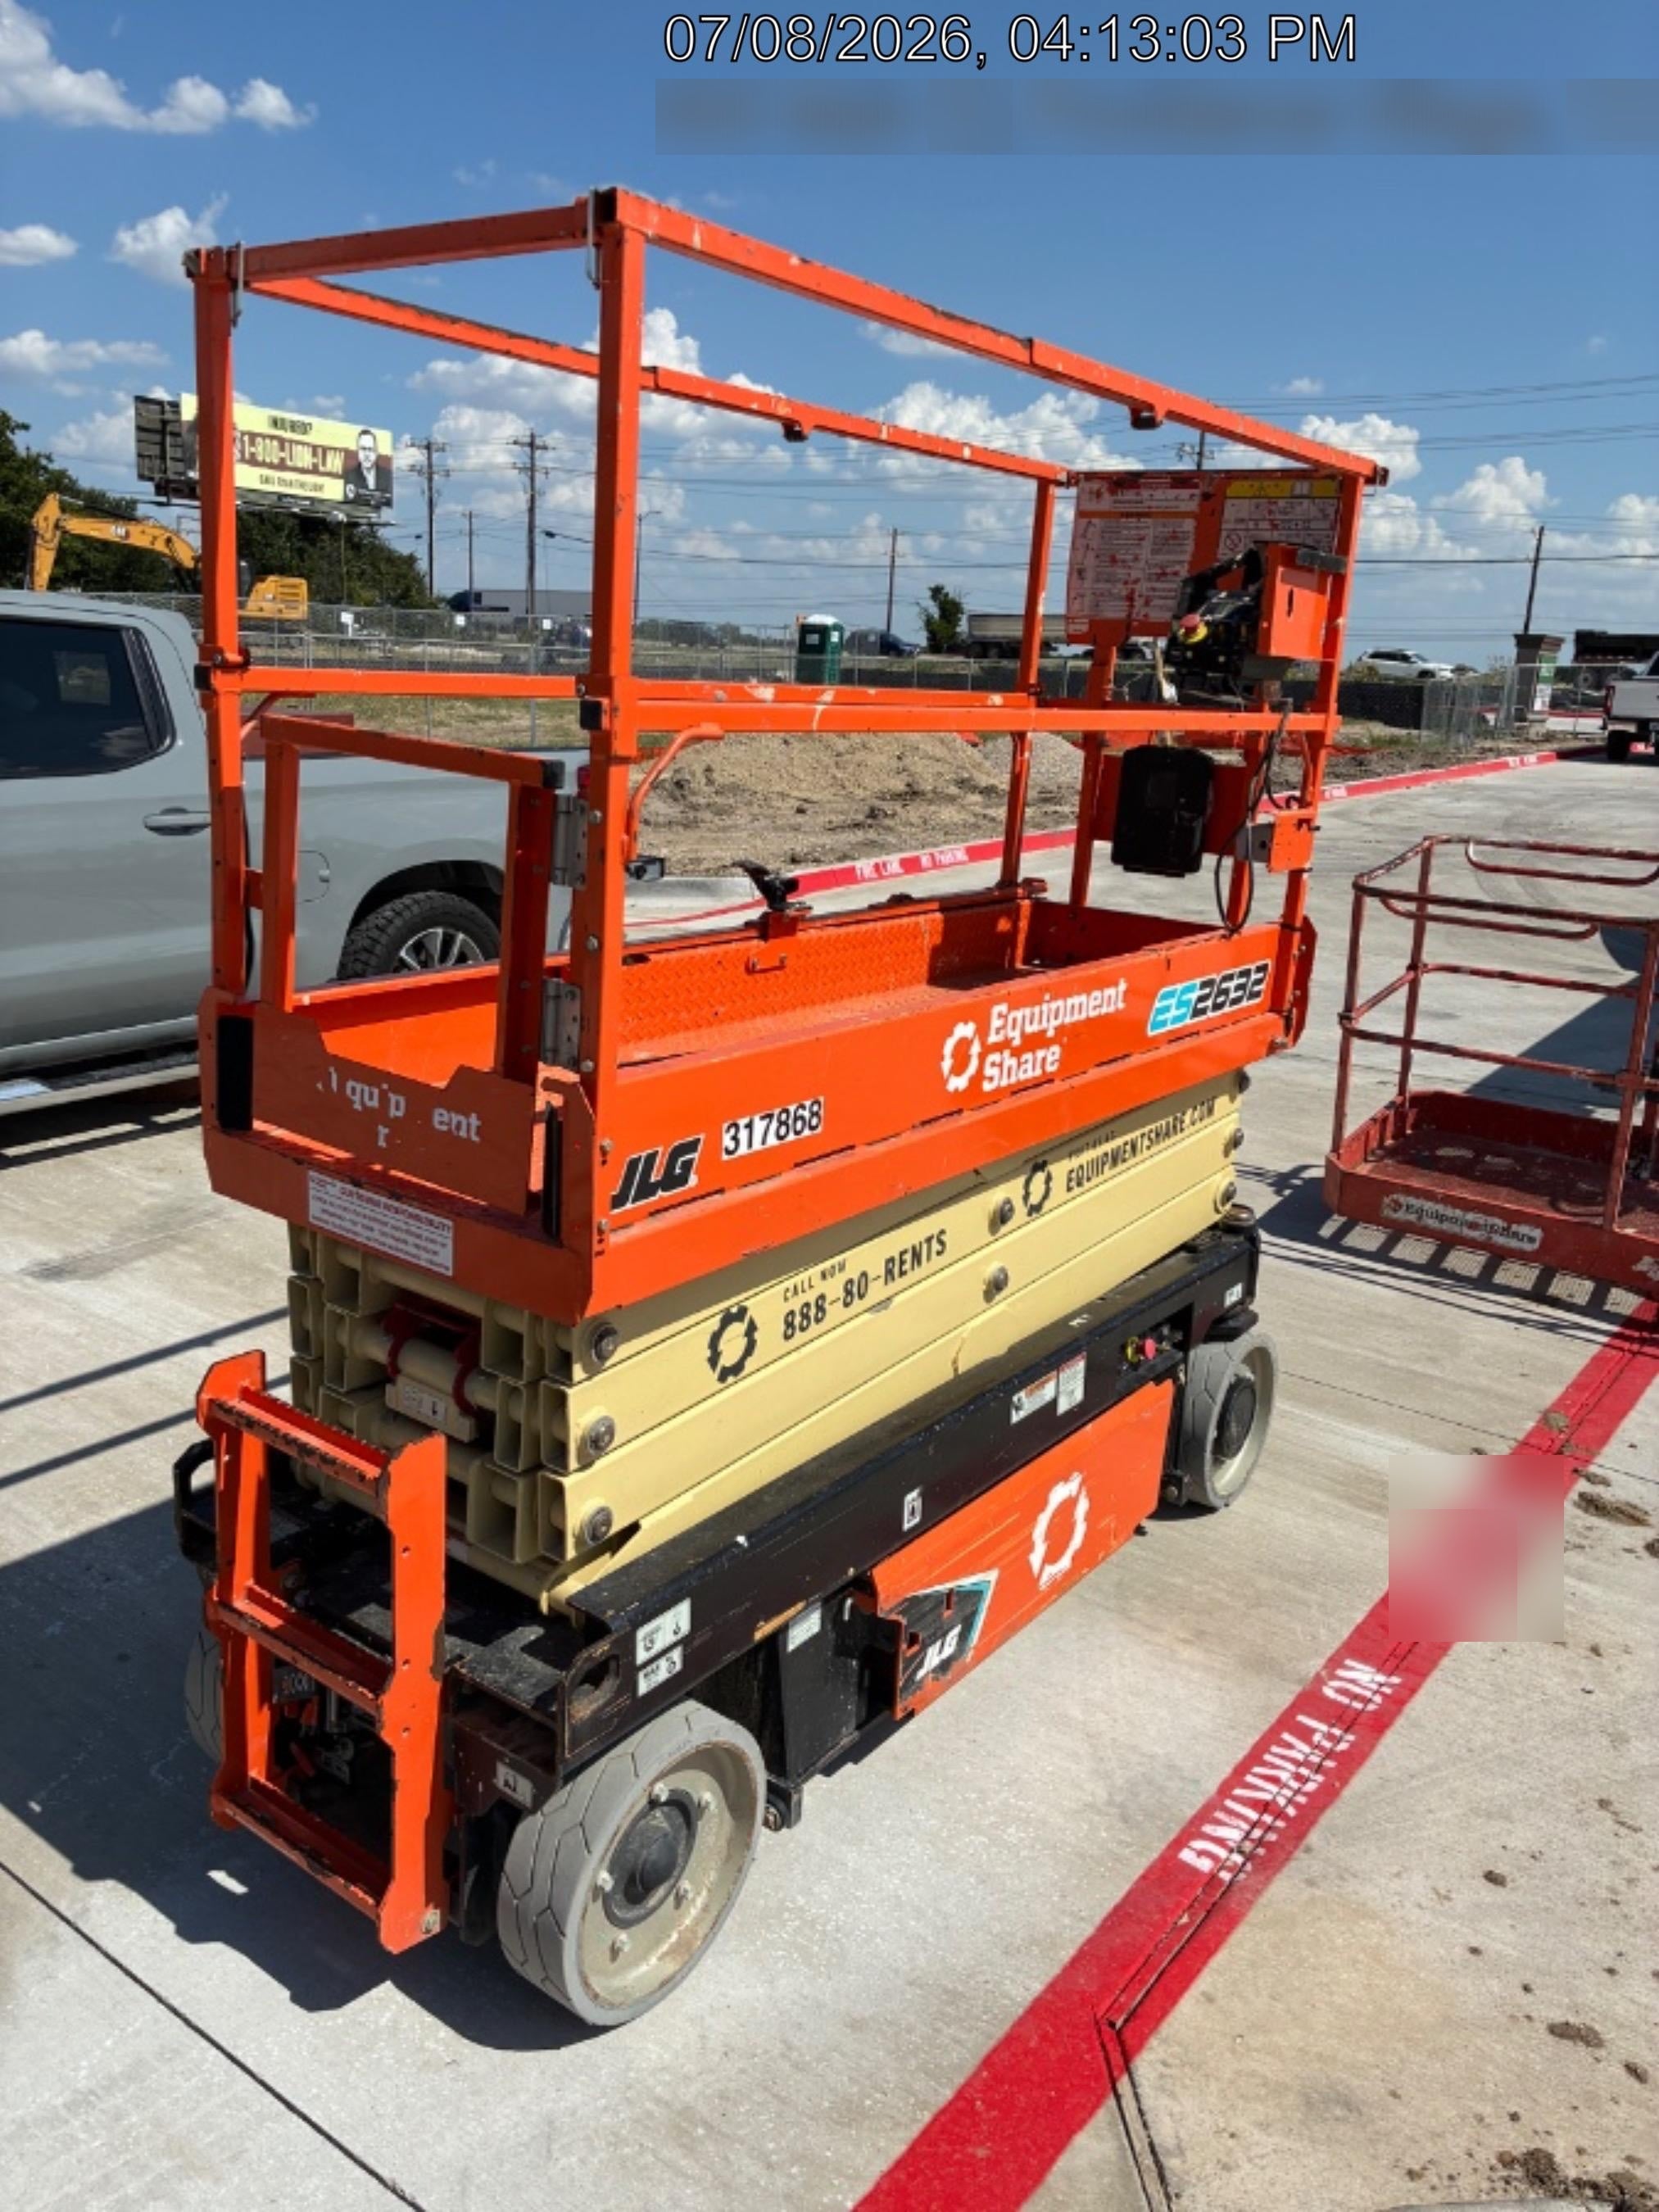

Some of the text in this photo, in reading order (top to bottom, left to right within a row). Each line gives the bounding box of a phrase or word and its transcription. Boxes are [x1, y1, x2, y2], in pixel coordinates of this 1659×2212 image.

[987, 977, 1127, 1047] Equipment
[1148, 959, 1270, 1036] ES2632
[983, 1044, 1060, 1093] Share
[723, 1099, 822, 1156] 317868
[1067, 1096, 1218, 1191] EQUIPMENTSHARE.COM
[610, 1135, 703, 1214] JLG
[783, 1258, 846, 1303] CALL NOW
[783, 1229, 947, 1340] 888-80-RENTS
[1321, 1658, 1402, 1712] NO
[1176, 1715, 1357, 1883] PARKING
